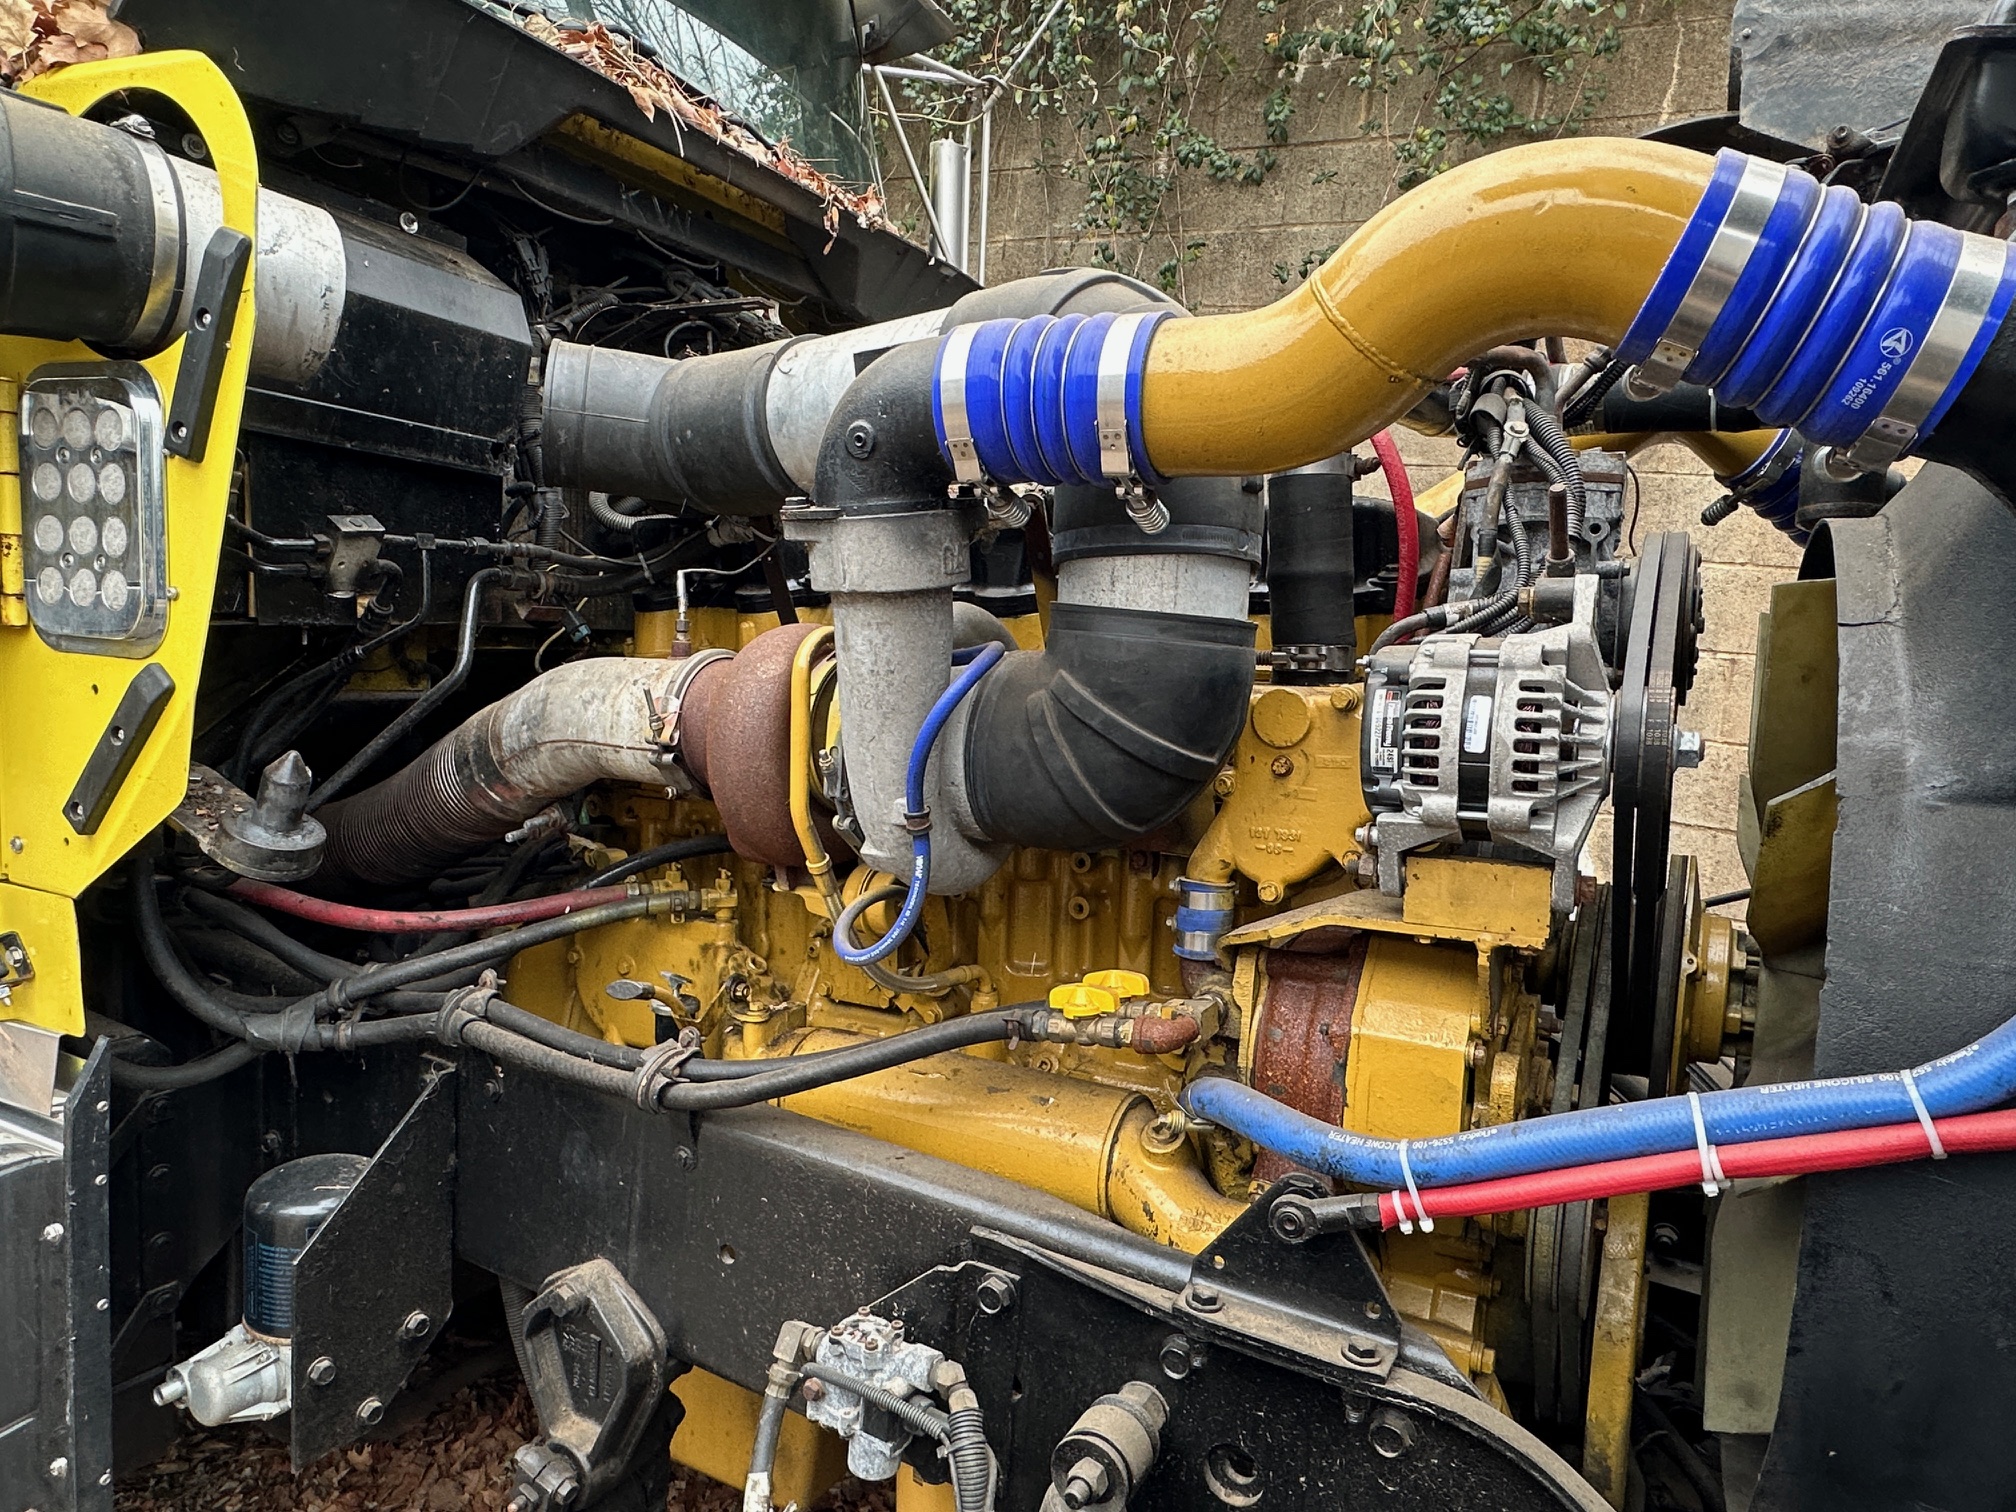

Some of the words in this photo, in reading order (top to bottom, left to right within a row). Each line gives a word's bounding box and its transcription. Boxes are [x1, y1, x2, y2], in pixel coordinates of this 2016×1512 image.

[1851, 361, 1893, 410] 561.16400
[1759, 1082, 1811, 1095] HEATER
[1813, 1075, 1874, 1089] SILICONE
[1327, 1130, 1365, 1147] HEATER
